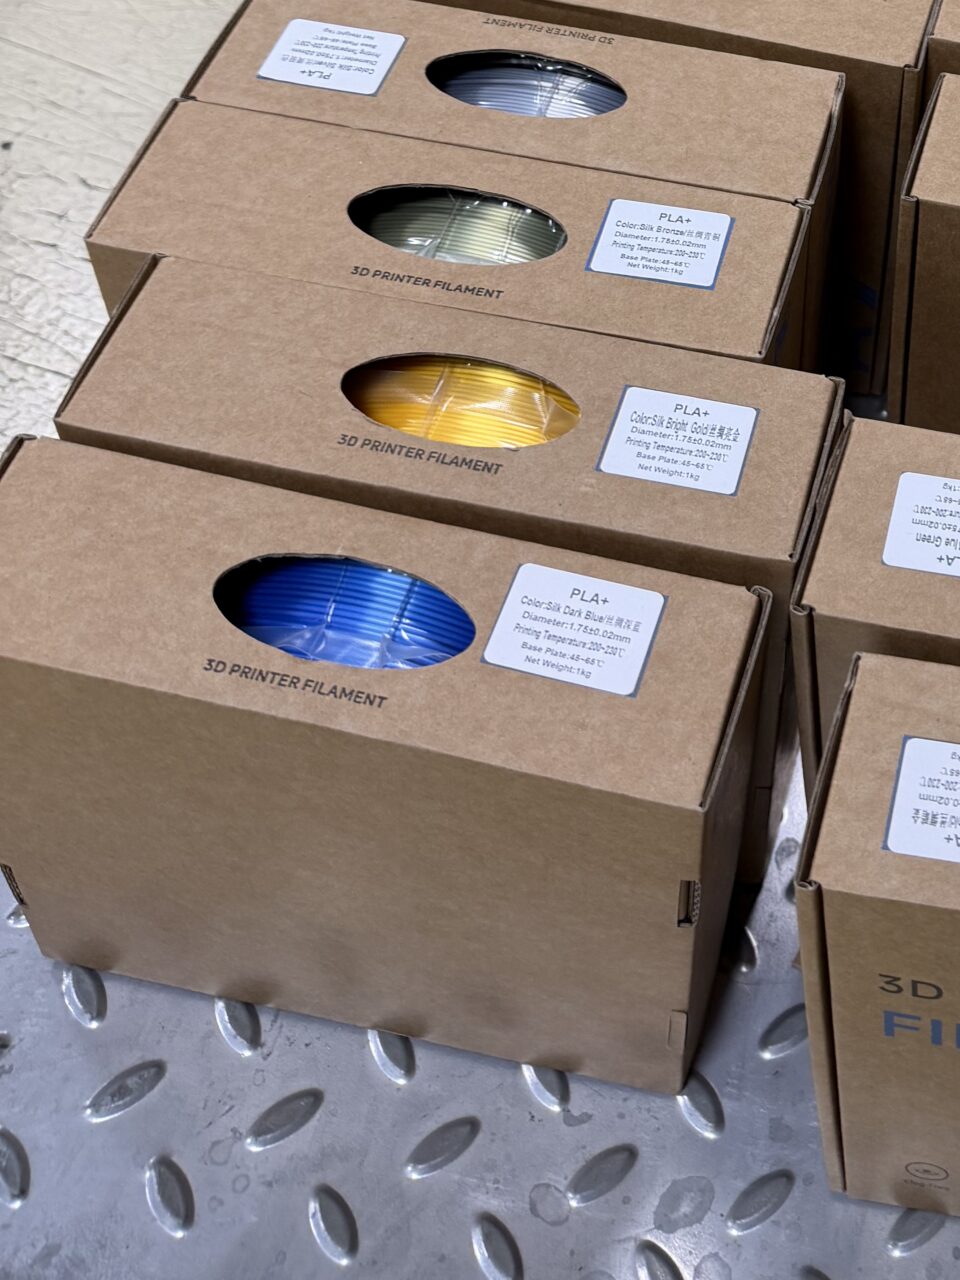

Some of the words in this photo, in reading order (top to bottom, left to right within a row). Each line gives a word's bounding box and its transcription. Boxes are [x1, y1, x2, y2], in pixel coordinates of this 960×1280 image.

[481, 17, 545, 33] FILAMENT
[545, 26, 597, 42] PRINTER
[597, 36, 616, 45] 3D
[299, 69, 332, 80] PLA+
[615, 219, 655, 232] Color:Silk
[658, 212, 692, 224] PLA+
[611, 239, 636, 252] Printing
[620, 253, 639, 261] Base
[626, 261, 641, 269] Net
[350, 265, 371, 277] 3D
[371, 269, 432, 288] PRINTER
[432, 280, 505, 300] FILAMENT
[673, 403, 710, 418] PLA+
[629, 410, 666, 428] Color:Silk
[665, 416, 689, 434] Bright
[625, 435, 652, 451] Printing
[336, 433, 359, 447] 3D
[359, 437, 426, 461] PRINTER
[425, 450, 504, 476] FILAMENT
[635, 451, 657, 461] Base
[637, 463, 653, 472] Net
[915, 532, 943, 548] Green
[569, 587, 610, 606] PLA+
[520, 595, 562, 613] Color:Silk
[562, 604, 583, 618] Dark
[513, 622, 542, 640] Printing
[520, 641, 544, 653] Base
[524, 654, 541, 665] Net
[202, 658, 227, 674] 3D
[228, 663, 301, 690] PRINTER
[300, 678, 389, 709] FILAMENT
[878, 973, 944, 1000] 3D
